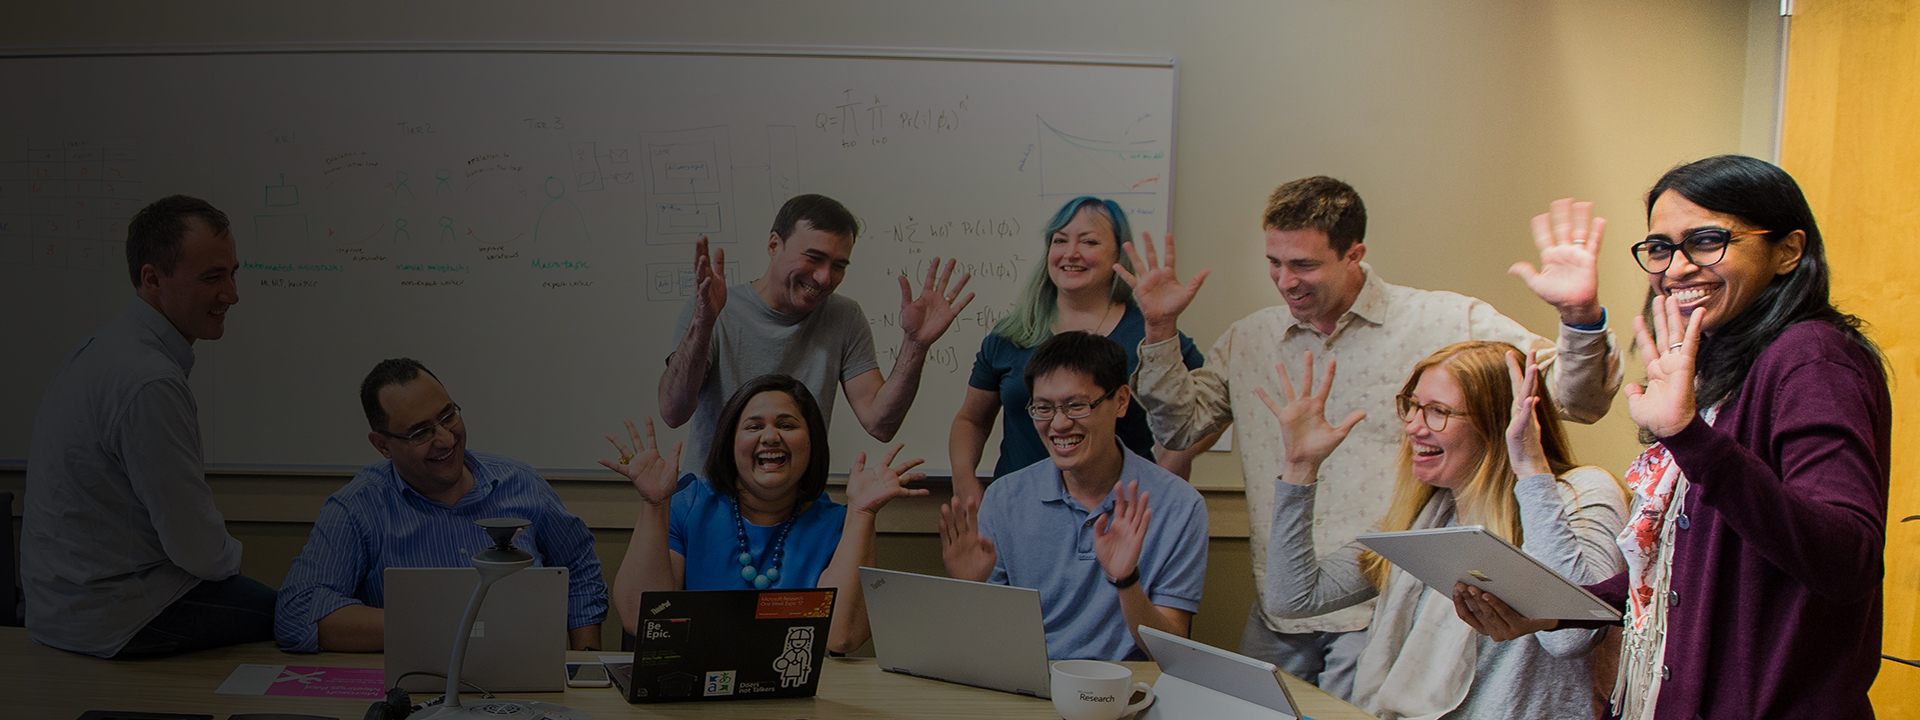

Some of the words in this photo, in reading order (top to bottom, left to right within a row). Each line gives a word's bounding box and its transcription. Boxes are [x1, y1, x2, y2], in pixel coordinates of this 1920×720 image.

[650, 599, 672, 615] ThinkPad
[647, 622, 662, 630] Be
[646, 630, 671, 640] Epic.
[1079, 693, 1115, 703] Research
